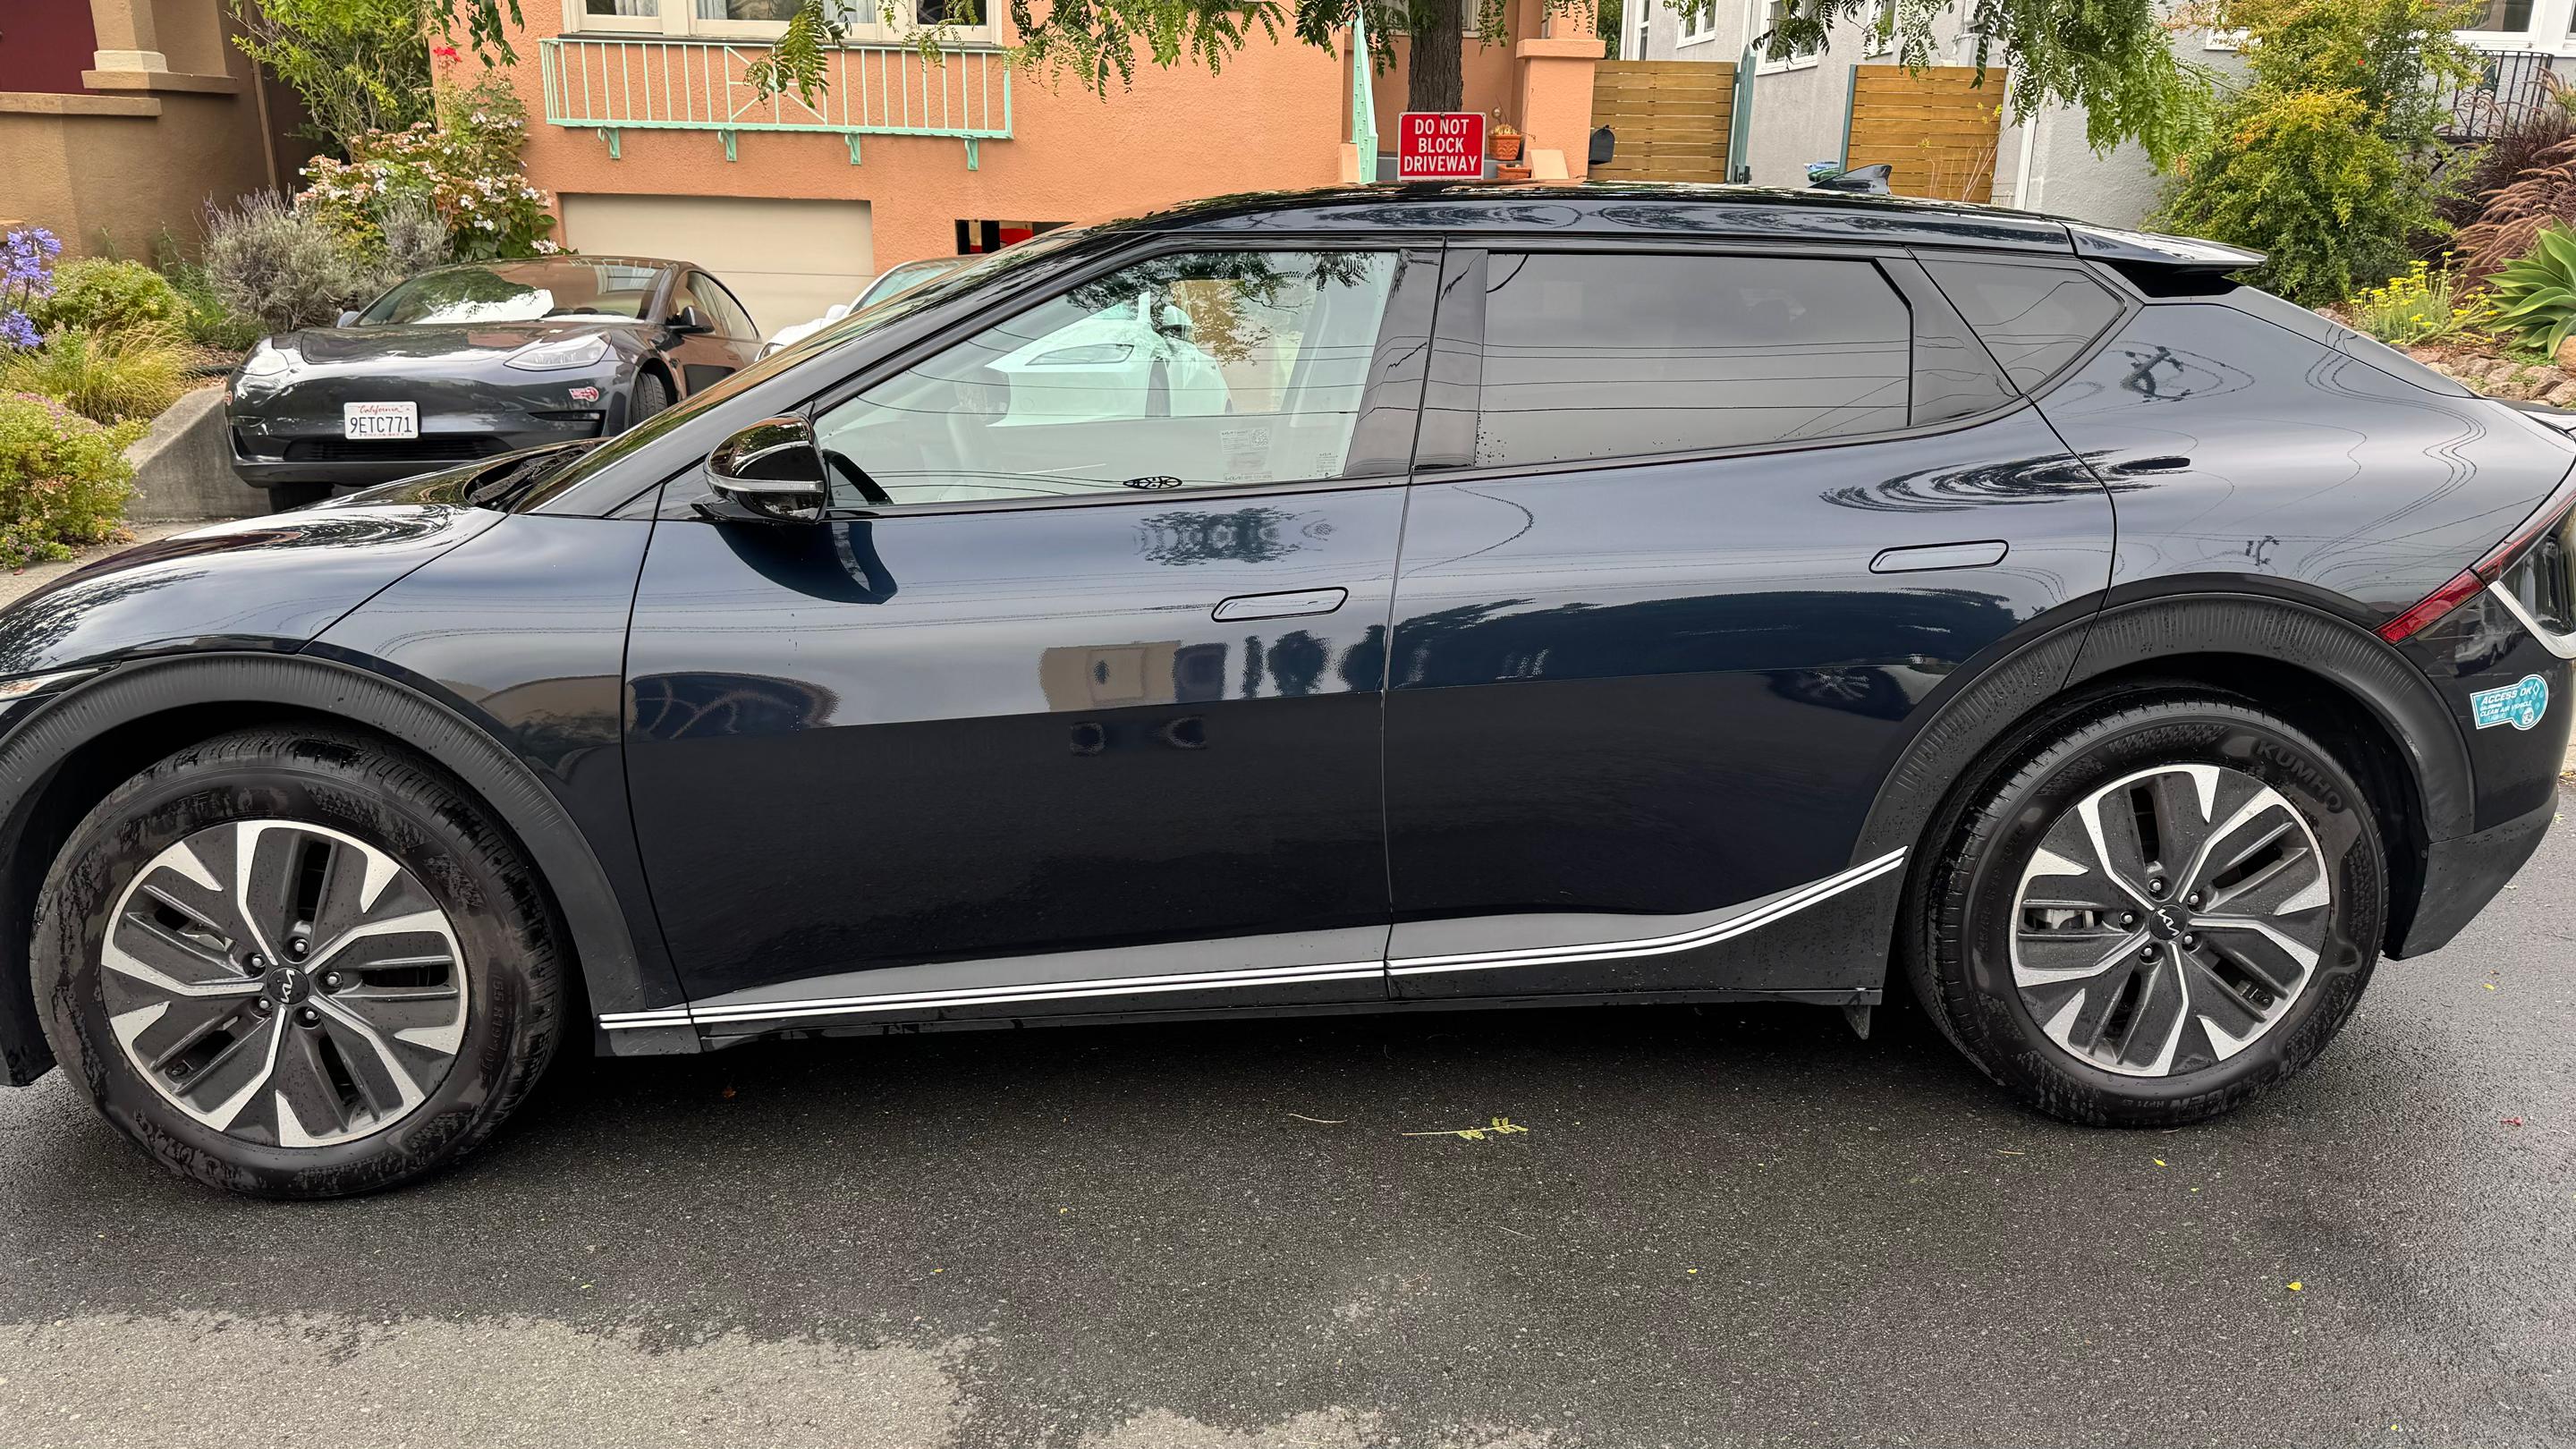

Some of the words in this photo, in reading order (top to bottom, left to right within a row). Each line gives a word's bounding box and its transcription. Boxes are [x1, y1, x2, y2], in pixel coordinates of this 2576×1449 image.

[1415, 118, 1435, 135] DO
[1439, 118, 1470, 135] NOT
[1418, 137, 1464, 154] BLOCK
[1403, 155, 1478, 173] DRIVEWAY
[358, 404, 402, 415] California
[350, 416, 412, 434] 9ETC771
[2480, 690, 2518, 705] ACCESS
[2520, 686, 2533, 697] OK
[2479, 708, 2499, 717] CLEAN
[2499, 705, 2511, 713] AIR
[2256, 740, 2343, 811] KUMHO
[2157, 908, 2181, 936] KIA
[280, 969, 295, 1004] KIA
